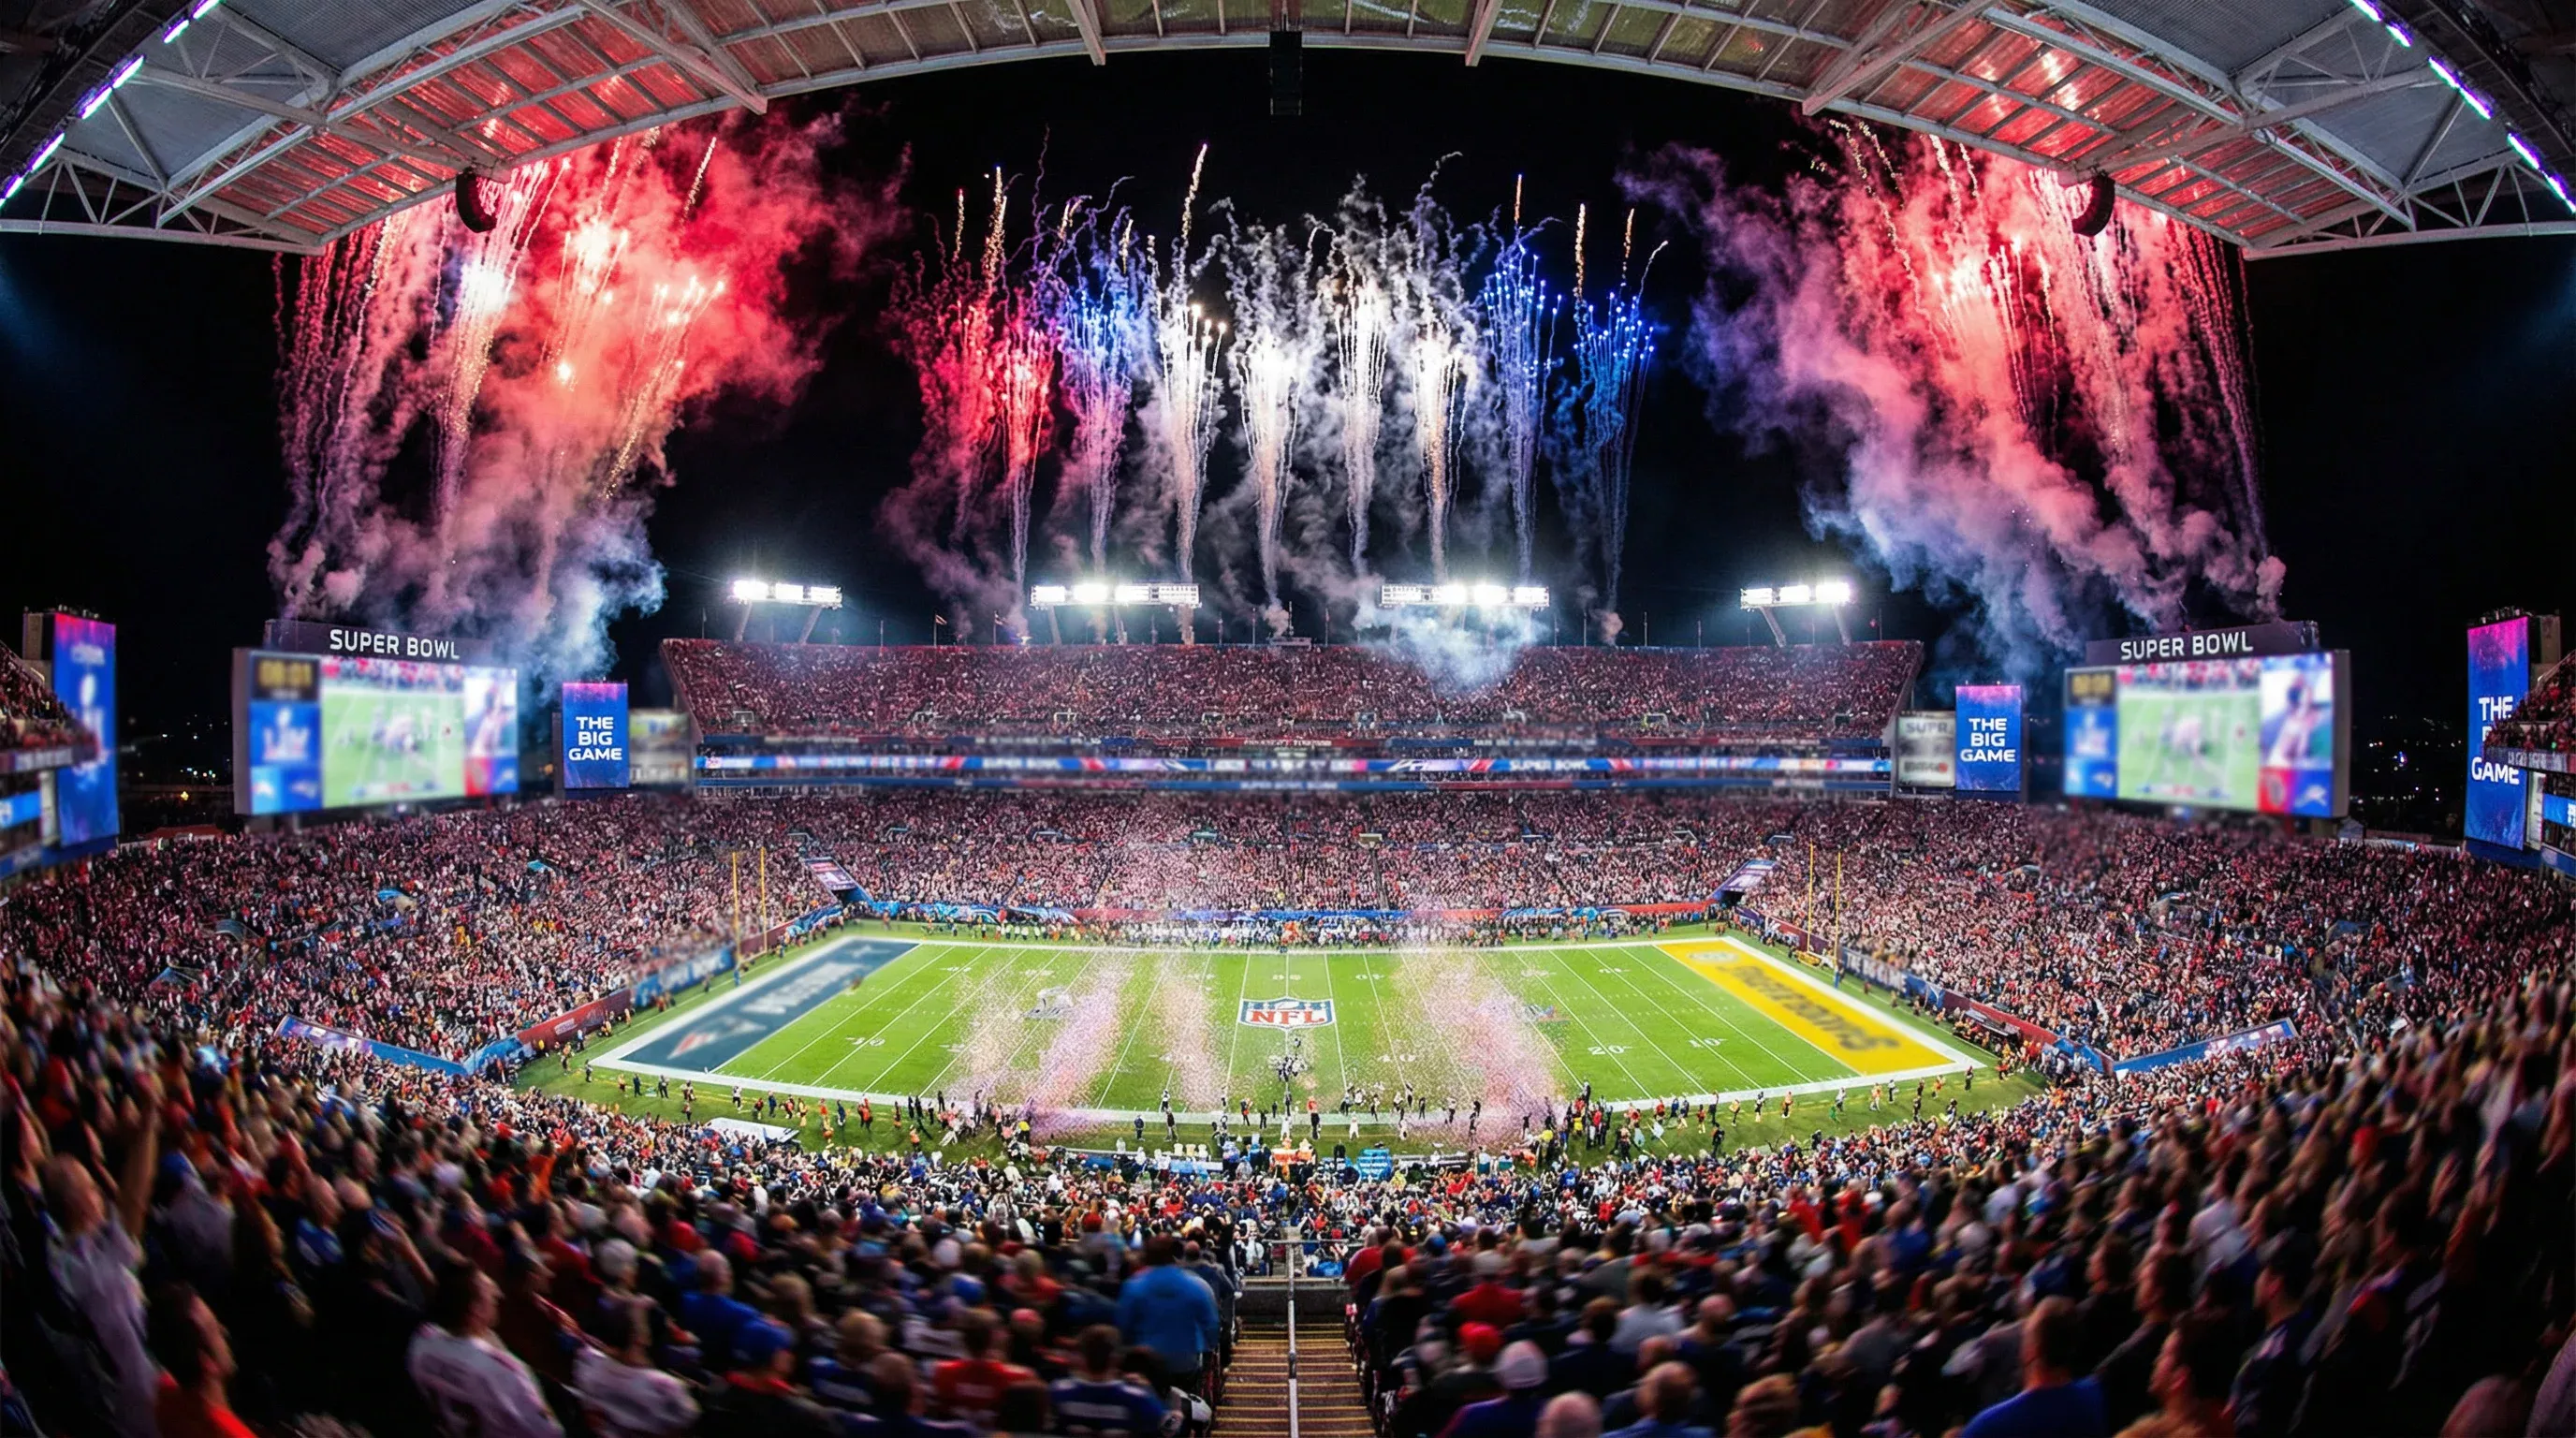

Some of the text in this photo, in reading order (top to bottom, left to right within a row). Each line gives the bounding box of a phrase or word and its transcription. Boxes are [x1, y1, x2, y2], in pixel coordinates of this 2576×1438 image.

[329, 628, 461, 659] SUPER BOWL
[2120, 630, 2254, 660] SUPER BOWL
[2478, 696, 2513, 721] THE
[575, 716, 614, 730] THE
[1968, 717, 2008, 731] THE
[578, 730, 613, 746] BIG
[1969, 732, 2006, 747] BIG
[567, 747, 623, 761] GAME
[1959, 748, 2017, 763] GAME
[2470, 756, 2521, 785] GAME
[1249, 1009, 1325, 1025] NFL
[1588, 1044, 1625, 1056] 20
